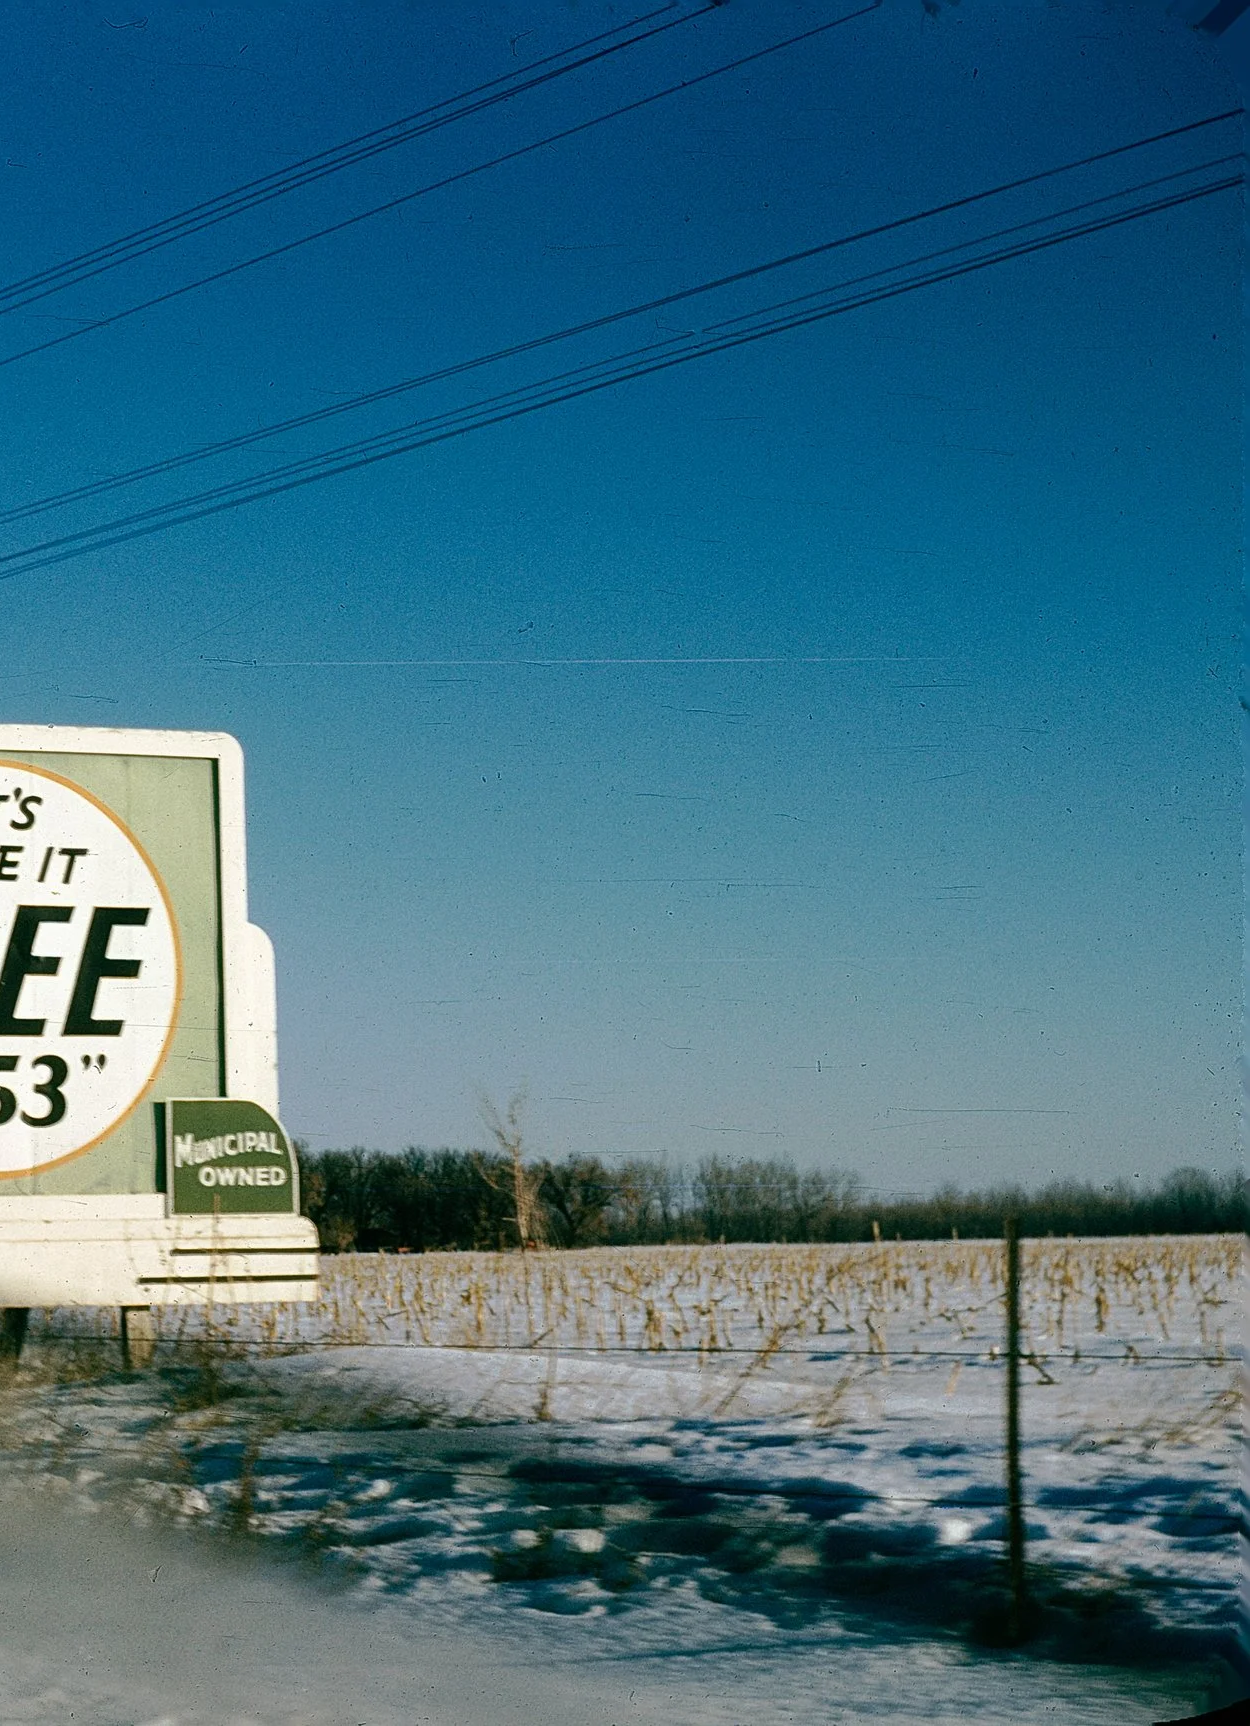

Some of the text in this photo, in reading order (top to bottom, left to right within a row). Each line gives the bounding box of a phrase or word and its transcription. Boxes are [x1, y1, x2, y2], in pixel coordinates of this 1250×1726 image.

[38, 846, 88, 884] IT
[174, 1131, 284, 1168] MUNICIPAL
[198, 1166, 286, 1186] OWNED
